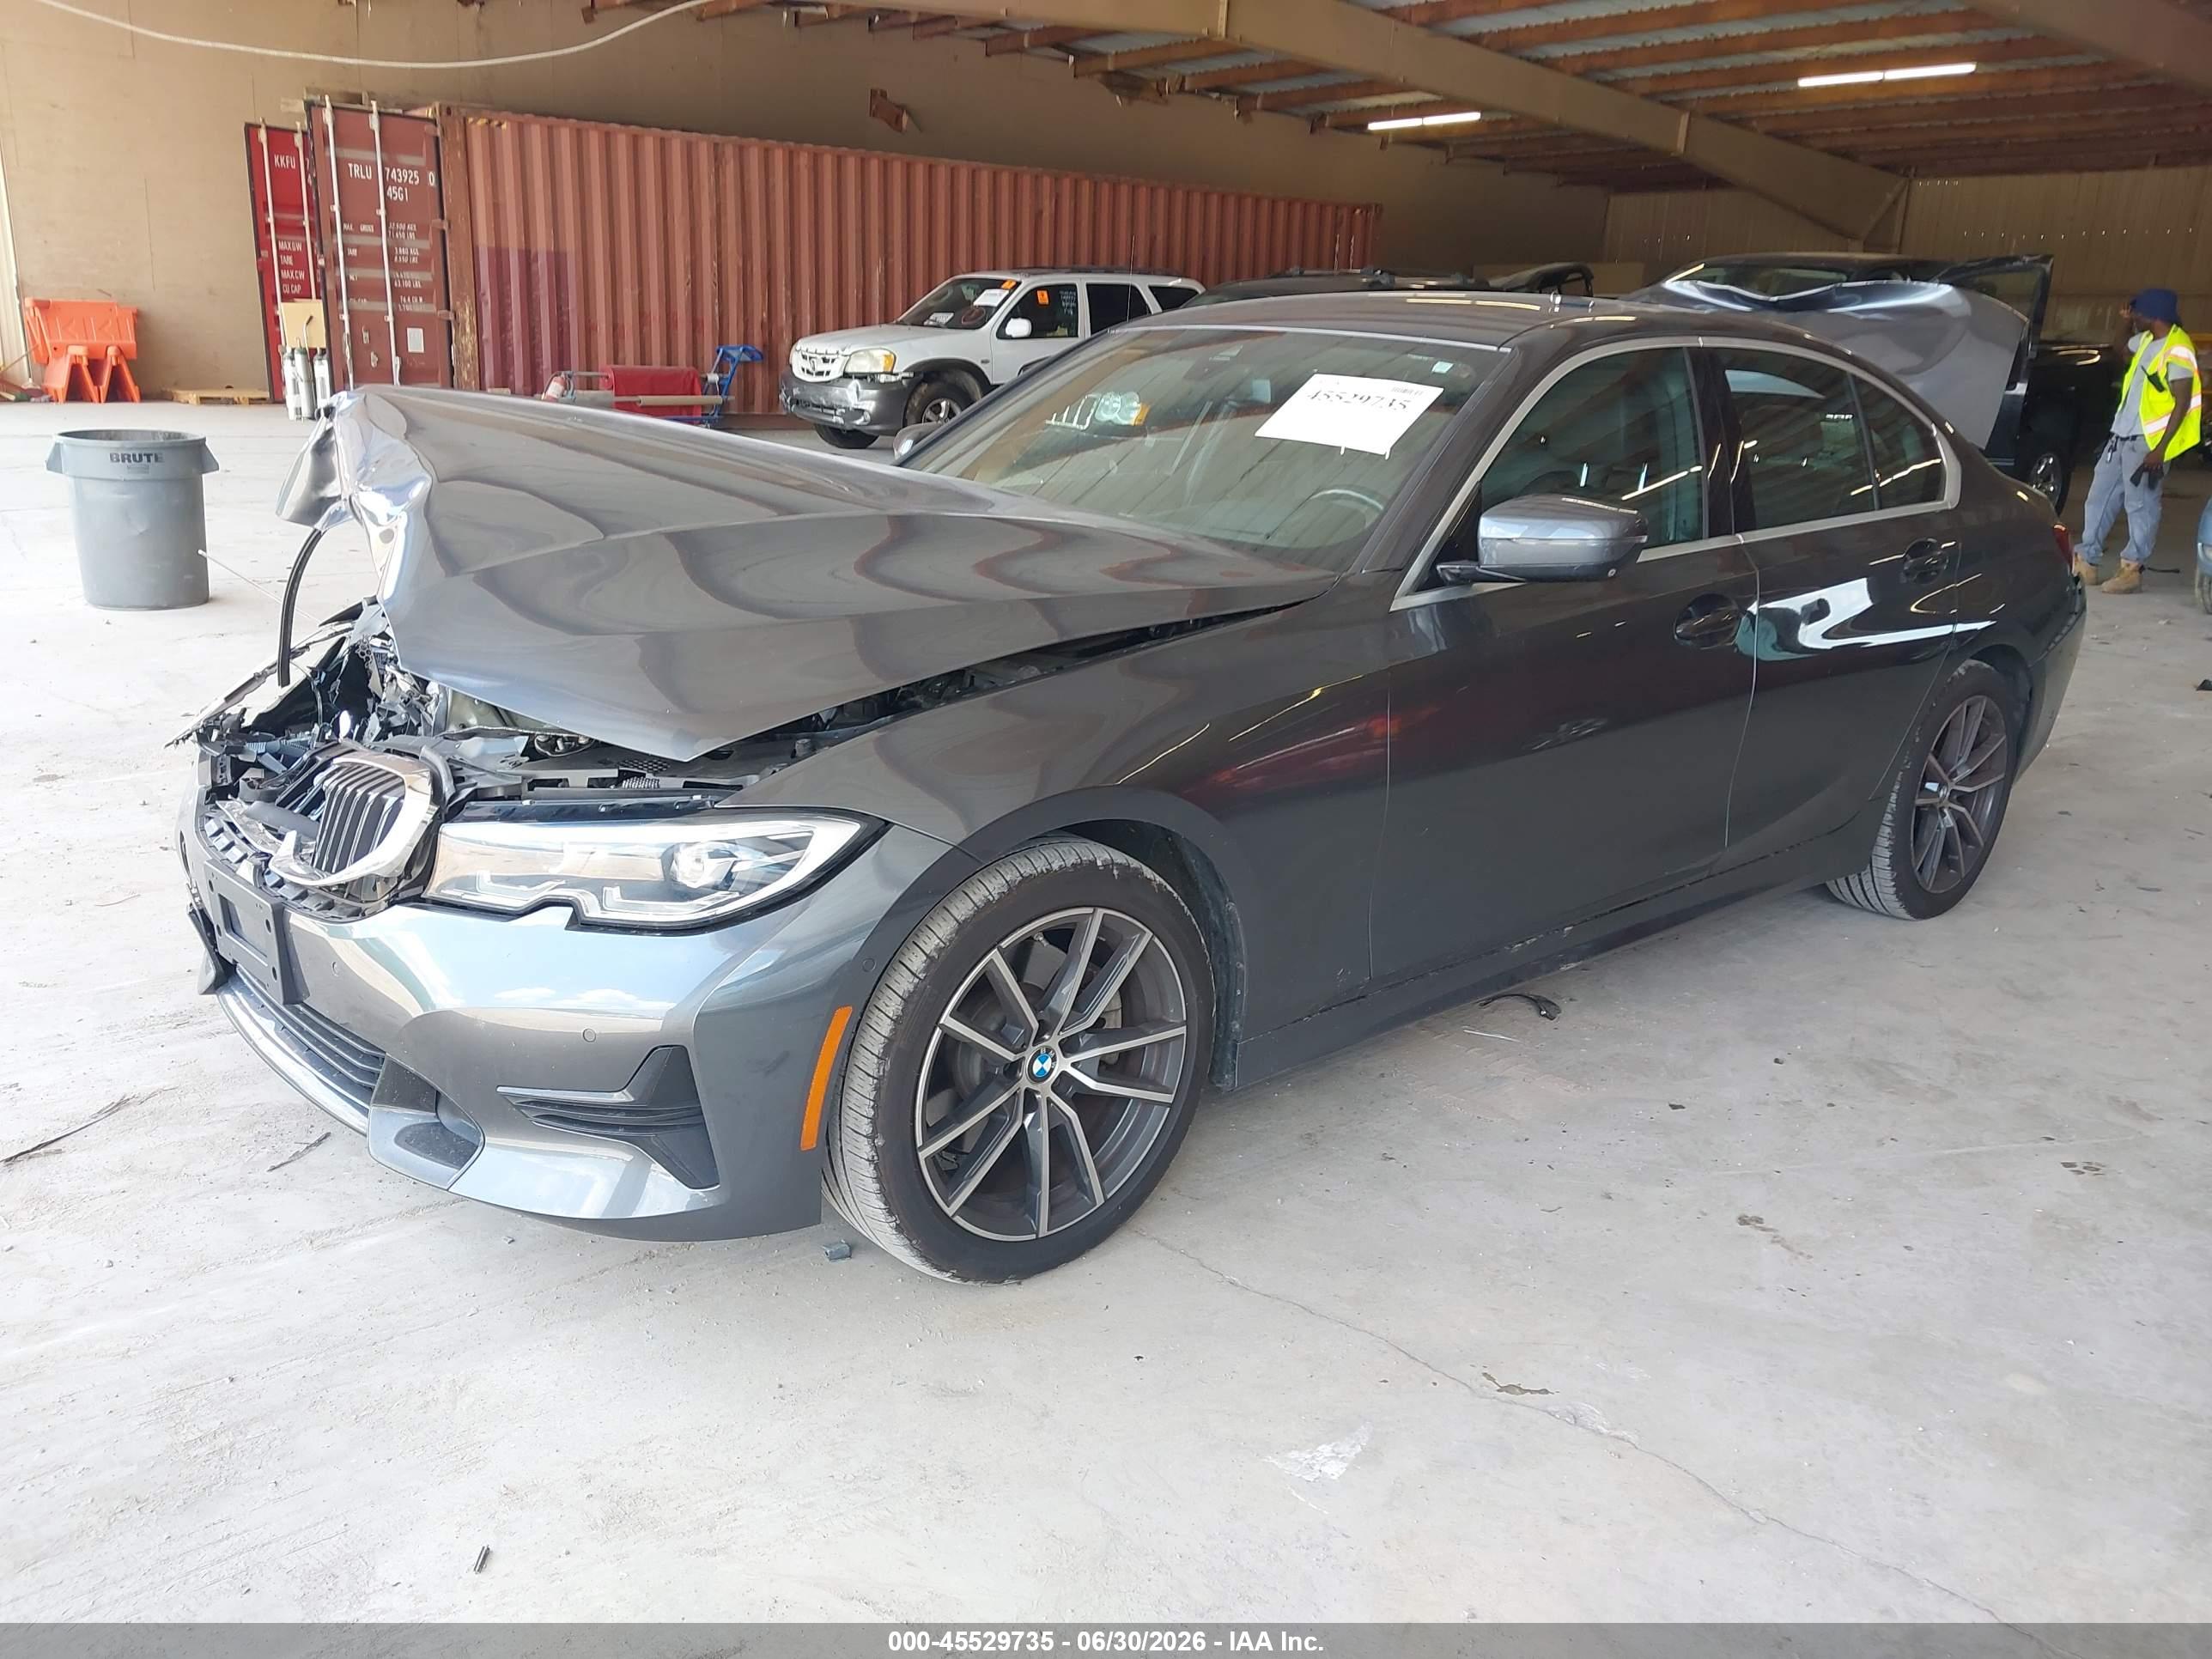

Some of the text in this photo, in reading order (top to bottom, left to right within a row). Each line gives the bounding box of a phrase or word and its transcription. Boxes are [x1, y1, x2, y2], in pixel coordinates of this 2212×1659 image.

[348, 162, 373, 180] TRLU
[384, 167, 420, 185] 743925
[386, 185, 409, 202] 45G1
[278, 240, 292, 252] MAX
[281, 270, 295, 280] MAX
[295, 270, 305, 281] CW
[283, 283, 301, 294] CU CAP
[109, 453, 165, 464] BRUTE
